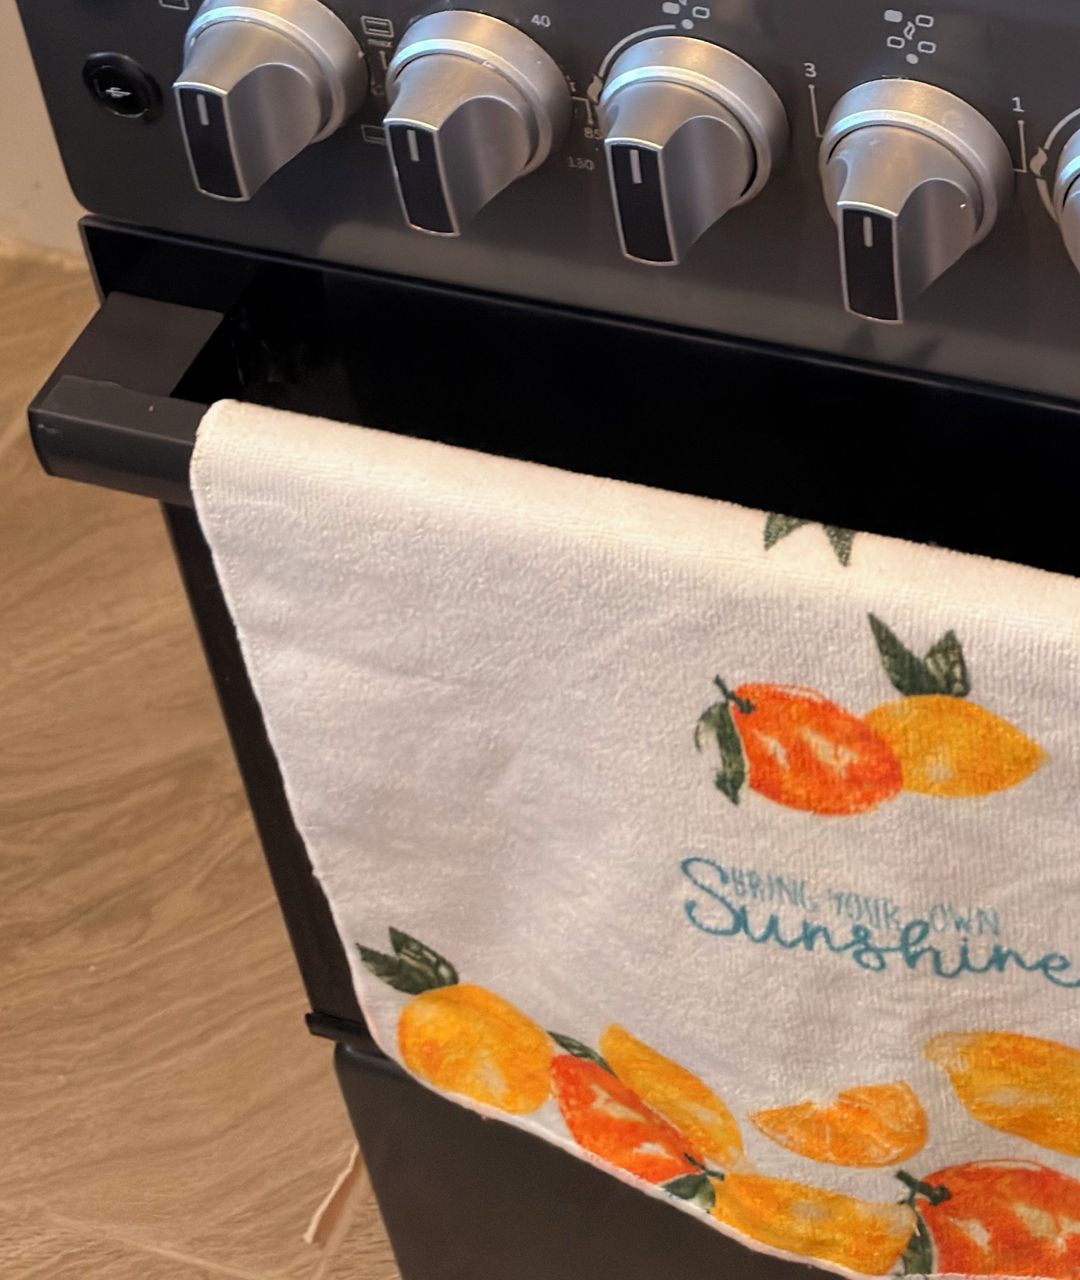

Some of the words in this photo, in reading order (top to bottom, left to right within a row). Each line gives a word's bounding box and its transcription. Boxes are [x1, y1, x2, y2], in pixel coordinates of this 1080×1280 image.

[531, 13, 551, 29] 40
[803, 62, 817, 78] 3
[1012, 97, 1025, 113] 1
